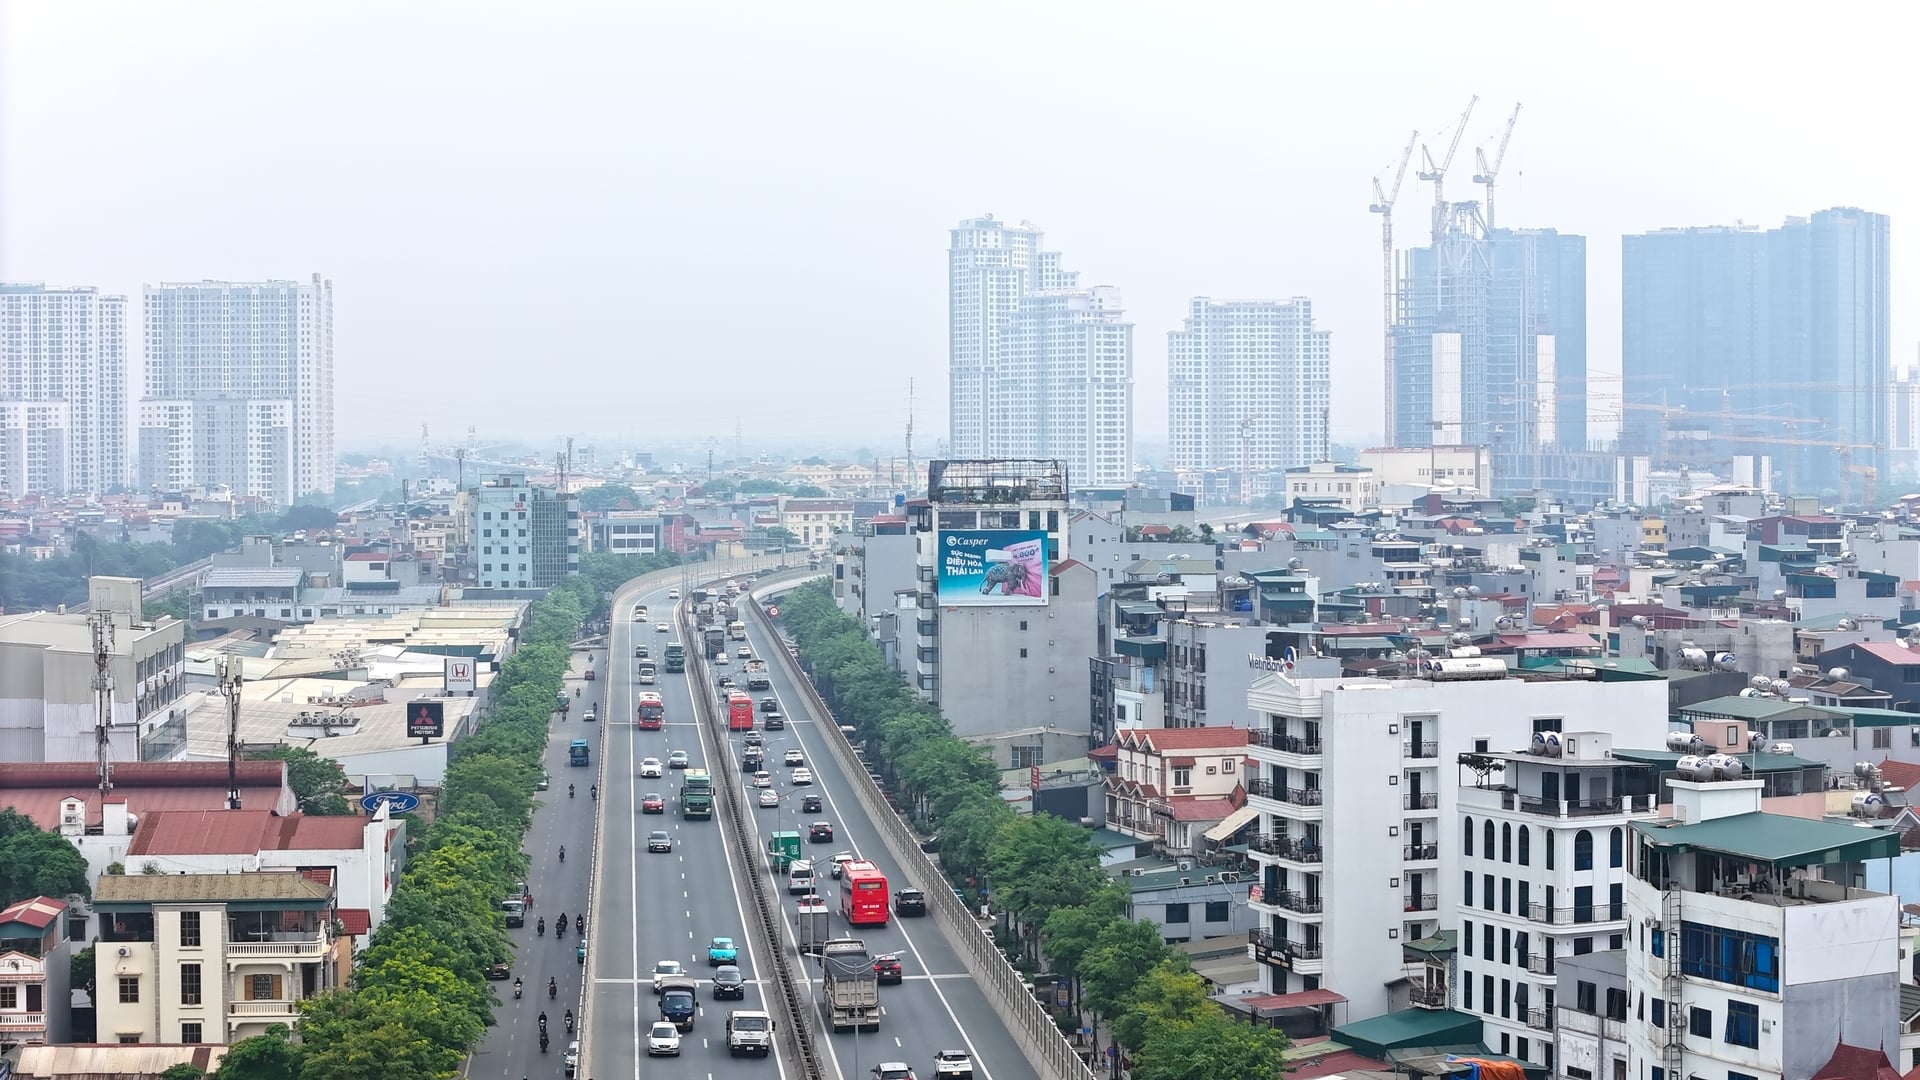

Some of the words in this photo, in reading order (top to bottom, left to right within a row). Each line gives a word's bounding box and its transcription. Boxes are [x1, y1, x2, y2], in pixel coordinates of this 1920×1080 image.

[957, 537, 989, 547] Casper
[968, 567, 984, 575] LAN
[1248, 653, 1286, 673] VietinBank
